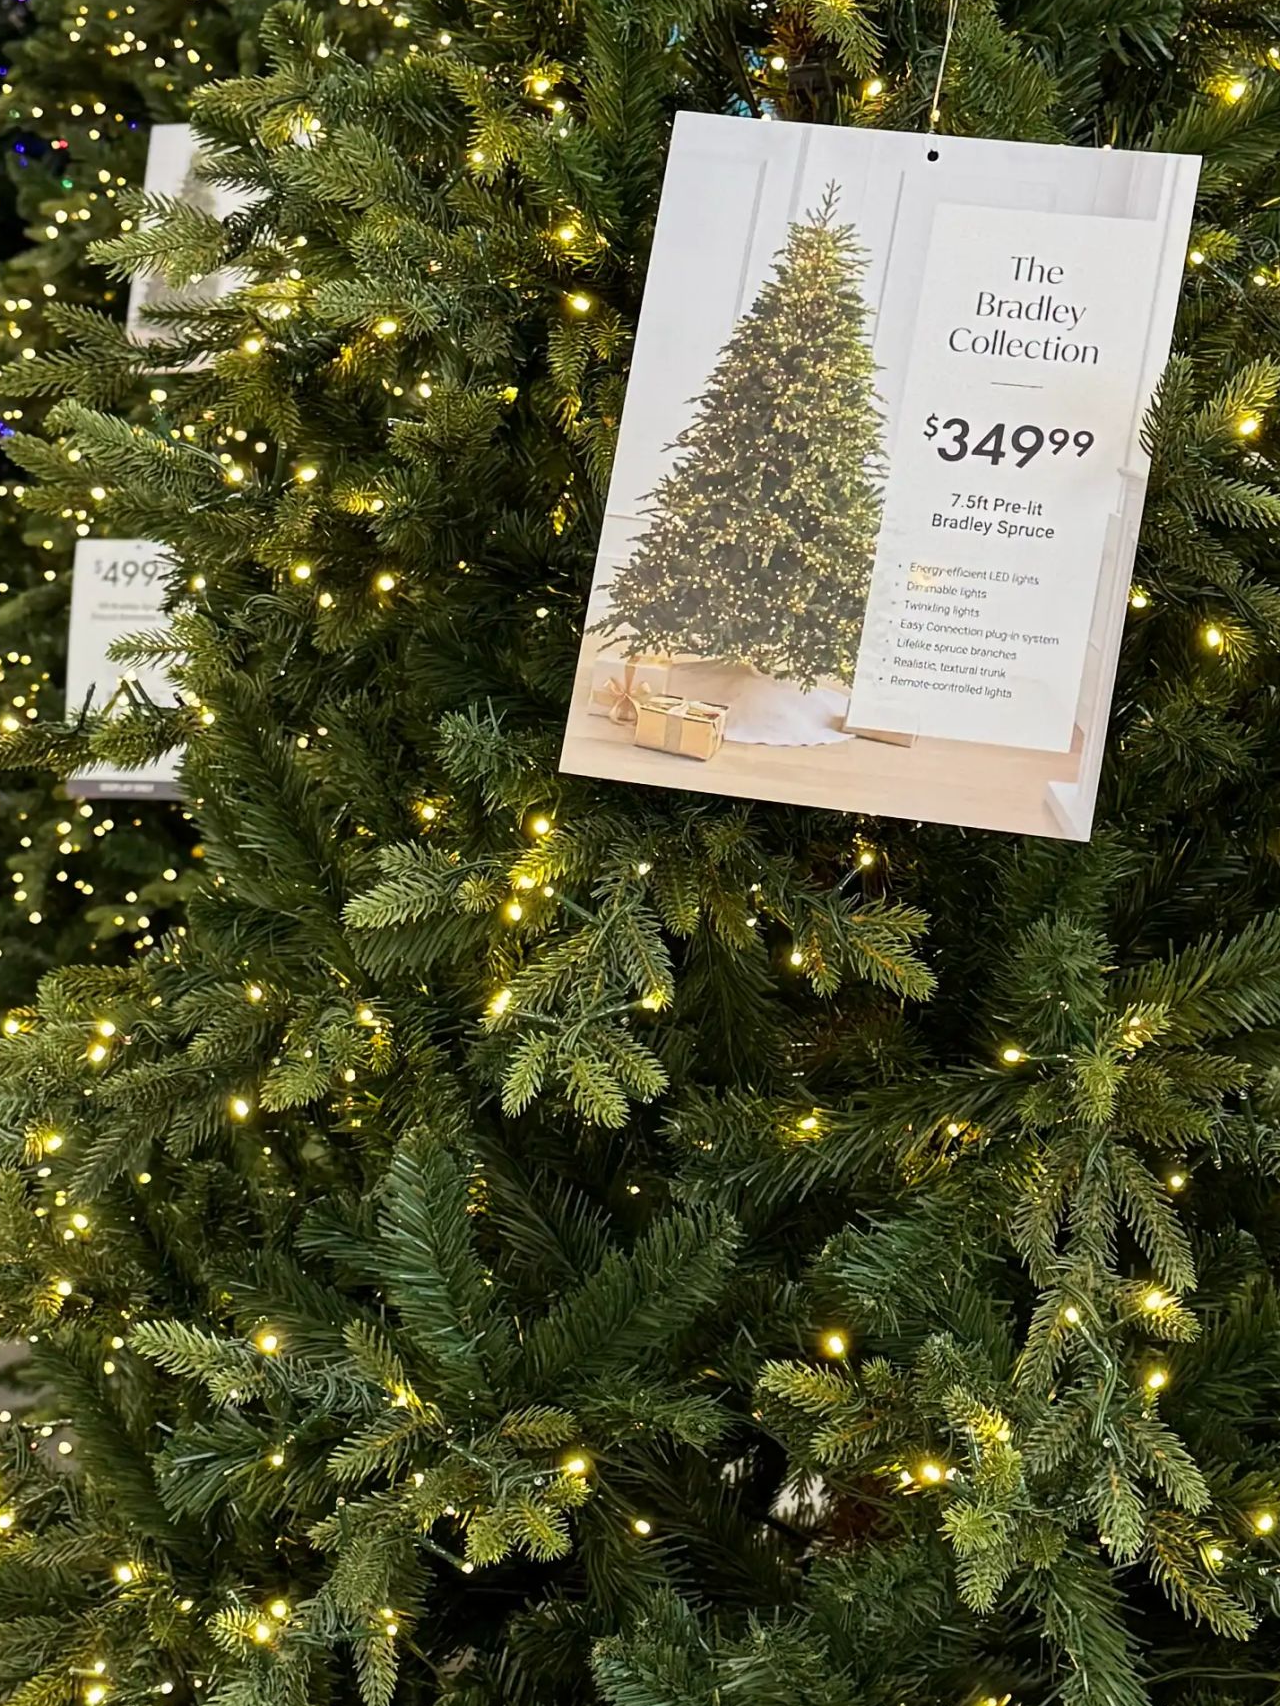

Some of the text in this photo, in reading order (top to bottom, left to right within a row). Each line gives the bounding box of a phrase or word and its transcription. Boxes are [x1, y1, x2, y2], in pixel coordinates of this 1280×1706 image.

[1012, 255, 1064, 285] The
[976, 292, 1087, 331] Bradley
[948, 327, 1099, 366] Collection
[951, 492, 1043, 518] 7.5ft Pre-lit
[931, 512, 1054, 543] Bradley Spruce
[989, 571, 1009, 581] LED
[1012, 572, 1039, 585] lights
[960, 587, 987, 599] lights
[905, 601, 980, 618] Twinkling lights
[900, 620, 1059, 645] Easy Connection plug-in system
[897, 639, 1016, 659] Lifelike spruce branches
[980, 667, 1006, 678] trunk
[891, 676, 1012, 699] Remote-controlled lights
